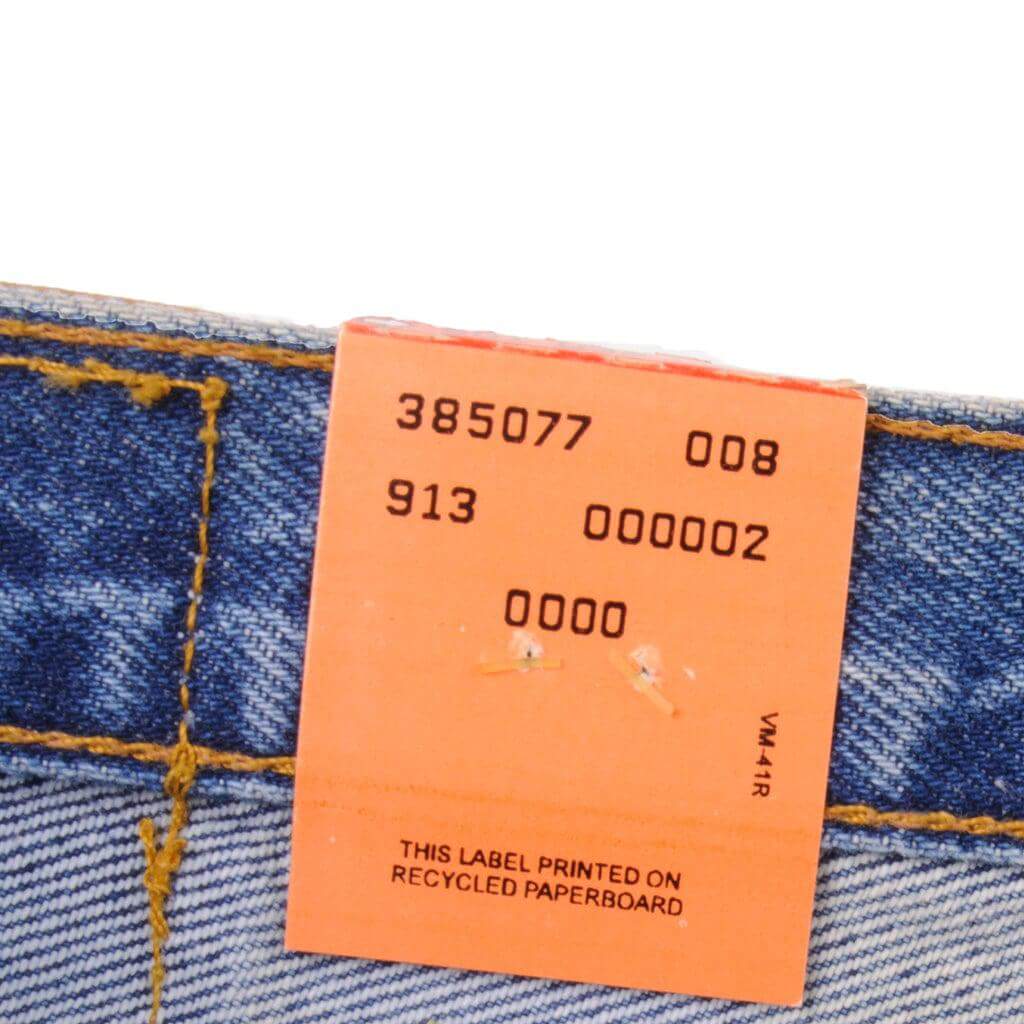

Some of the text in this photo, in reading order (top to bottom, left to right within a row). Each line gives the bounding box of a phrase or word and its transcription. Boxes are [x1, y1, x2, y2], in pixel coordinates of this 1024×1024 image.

[396, 393, 779, 476] 385077 008
[386, 479, 770, 561] 913 000002
[504, 589, 627, 639] 0000
[400, 840, 682, 891] THIS LABEL PRINTED ON
[391, 866, 683, 917] RECYCLED PAPERBOARD
